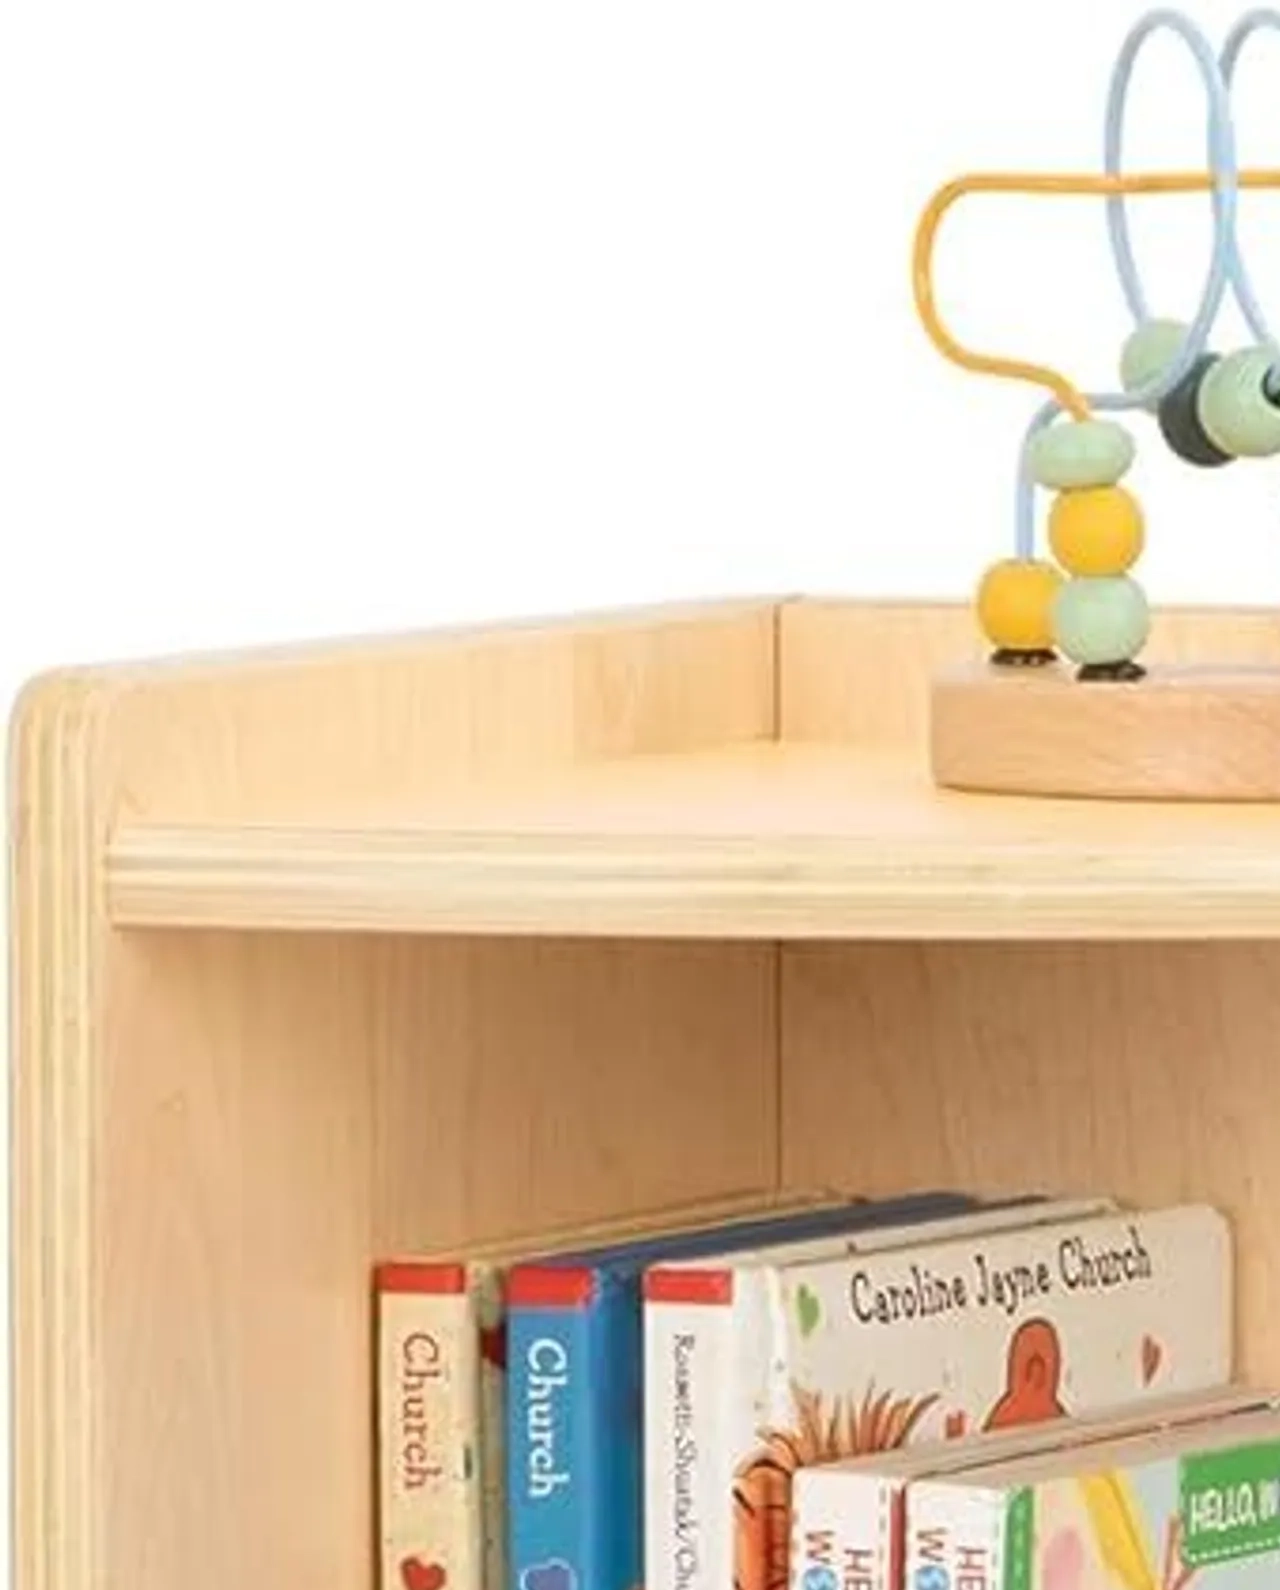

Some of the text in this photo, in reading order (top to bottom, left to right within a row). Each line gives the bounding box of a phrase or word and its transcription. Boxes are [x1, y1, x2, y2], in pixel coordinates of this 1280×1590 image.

[851, 1225, 1152, 1324] Caroline Jayne Church
[402, 1332, 442, 1491] Church
[526, 1337, 570, 1499] Church
